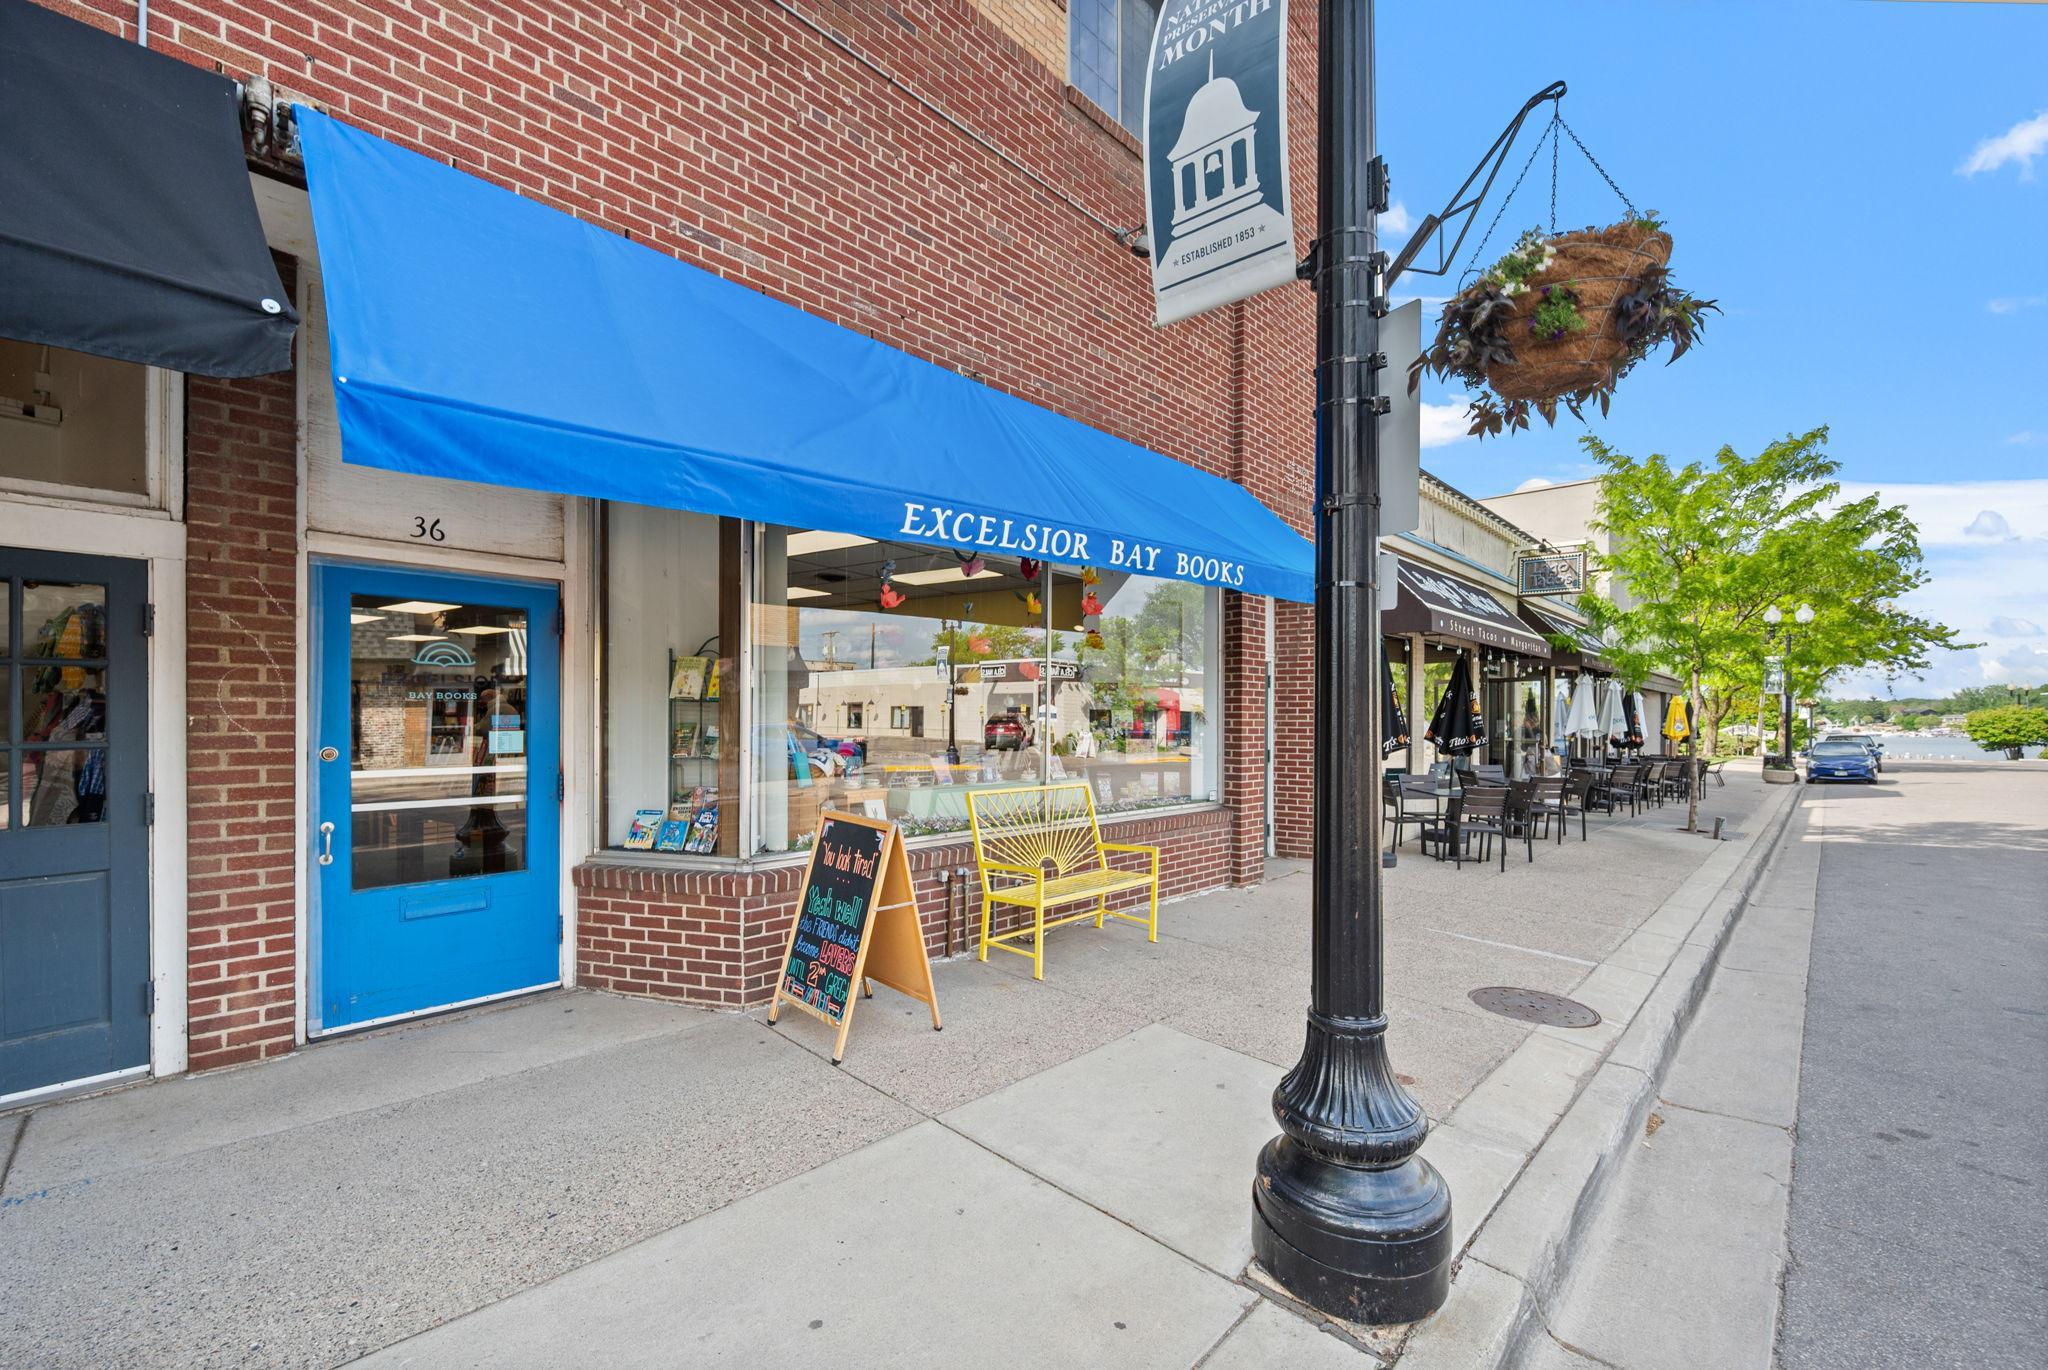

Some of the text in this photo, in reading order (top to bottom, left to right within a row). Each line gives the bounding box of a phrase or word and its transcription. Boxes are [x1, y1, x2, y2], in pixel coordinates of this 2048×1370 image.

[1163, 0, 1235, 45] PRESERV
[1166, 0, 1210, 31] NAT
[1159, 0, 1271, 71] MONTH
[1181, 227, 1255, 265] ESTABLISHED 1853
[410, 516, 445, 541] 36
[900, 502, 1245, 586] EXCELSIOR BAY BOOKS
[1450, 619, 1541, 653] Street Tacos Margaritas
[409, 691, 478, 700] BAY BOOKS
[1449, 736, 1470, 748] Tito's
[835, 844, 851, 872] look
[808, 885, 833, 918] Yeah
[787, 956, 806, 982] UNTIL
